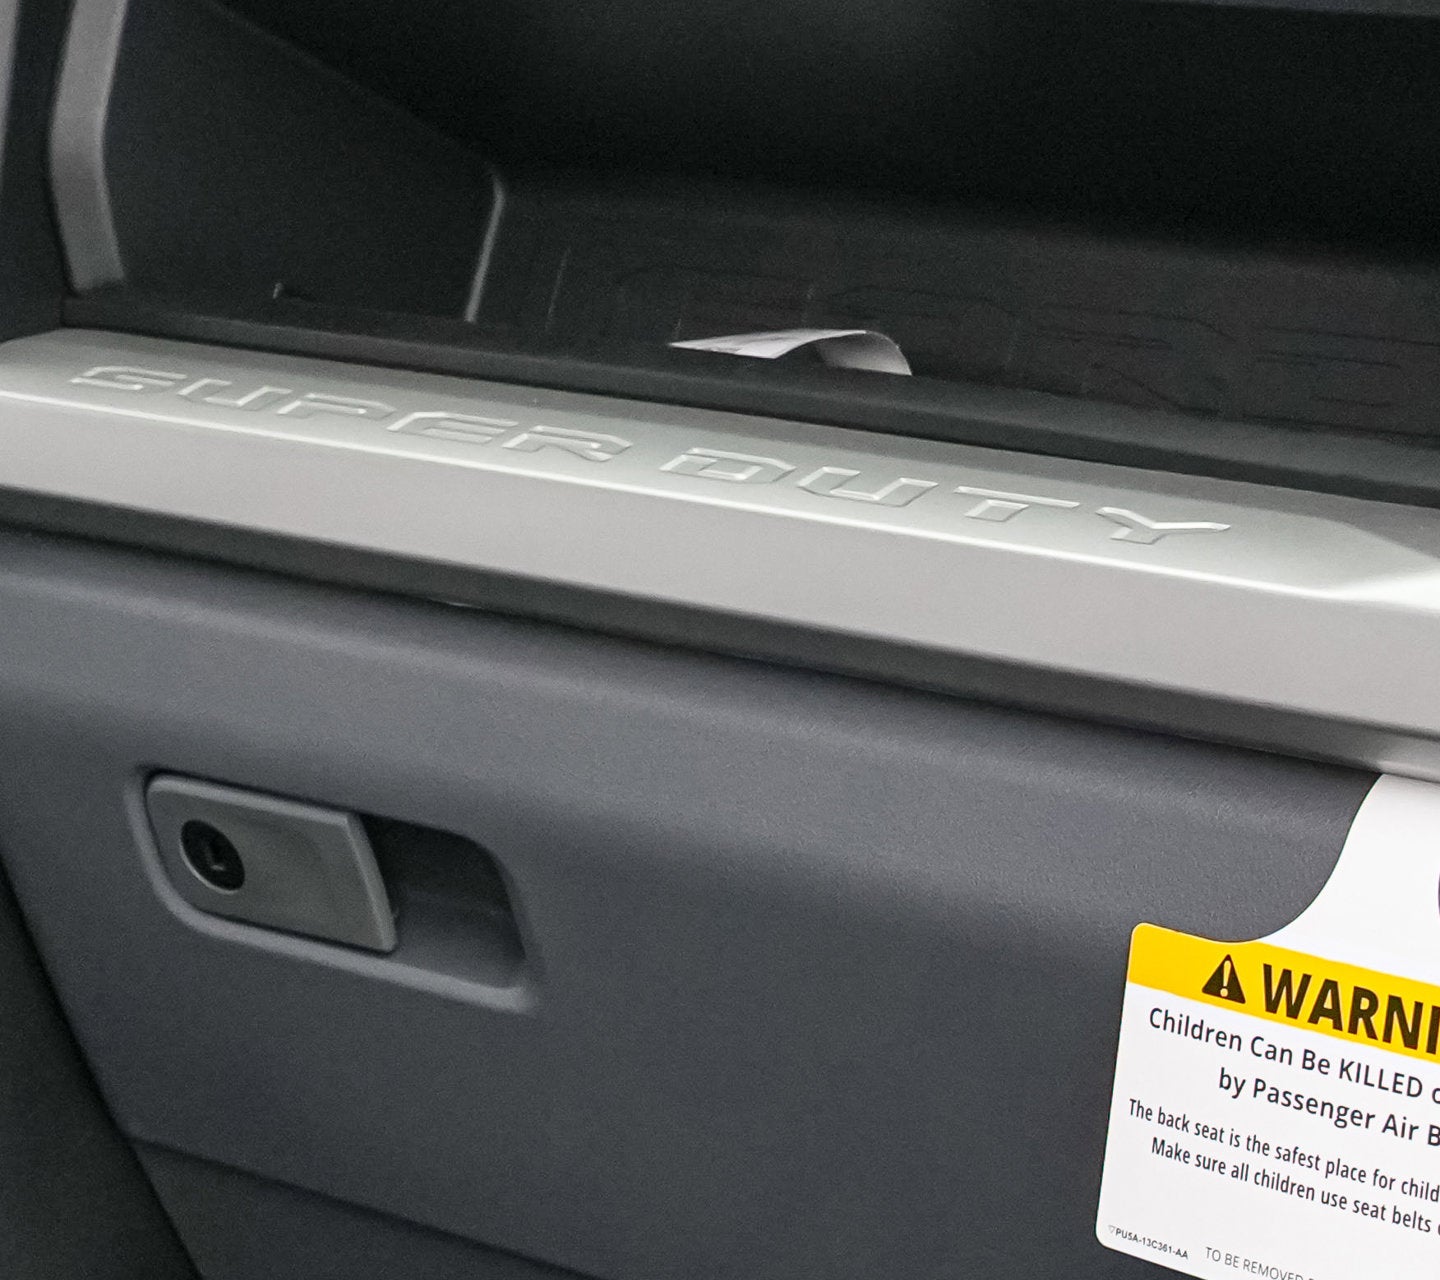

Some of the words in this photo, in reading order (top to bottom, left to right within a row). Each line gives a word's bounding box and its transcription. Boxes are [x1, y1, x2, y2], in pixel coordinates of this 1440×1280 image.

[69, 365, 634, 463] SUPER
[659, 447, 1231, 545] DUTY
[1149, 1007, 1242, 1052] Children
[1250, 1035, 1293, 1066] Can
[1301, 1048, 1331, 1076] Be
[1338, 1058, 1423, 1098] KILLED
[1129, 1098, 1153, 1122] The
[1157, 1106, 1190, 1133] back
[1194, 1122, 1225, 1144] seat
[1229, 1128, 1241, 1148] is
[1246, 1134, 1270, 1157] the
[1275, 1146, 1321, 1171] safest
[1325, 1158, 1367, 1184] place
[1372, 1168, 1396, 1191] for
[1219, 1066, 1246, 1100] by
[1253, 1077, 1376, 1129] Passenger
[1381, 1113, 1419, 1141] Air
[1151, 1136, 1191, 1165] Make
[1194, 1154, 1226, 1175] sure
[1230, 1162, 1250, 1182] all
[1254, 1168, 1315, 1201] children
[1321, 1190, 1348, 1210] use
[1352, 1199, 1387, 1221] seat
[1392, 1205, 1431, 1233] belts
[1205, 1246, 1222, 1263] TO
[1224, 1252, 1241, 1269] BE
